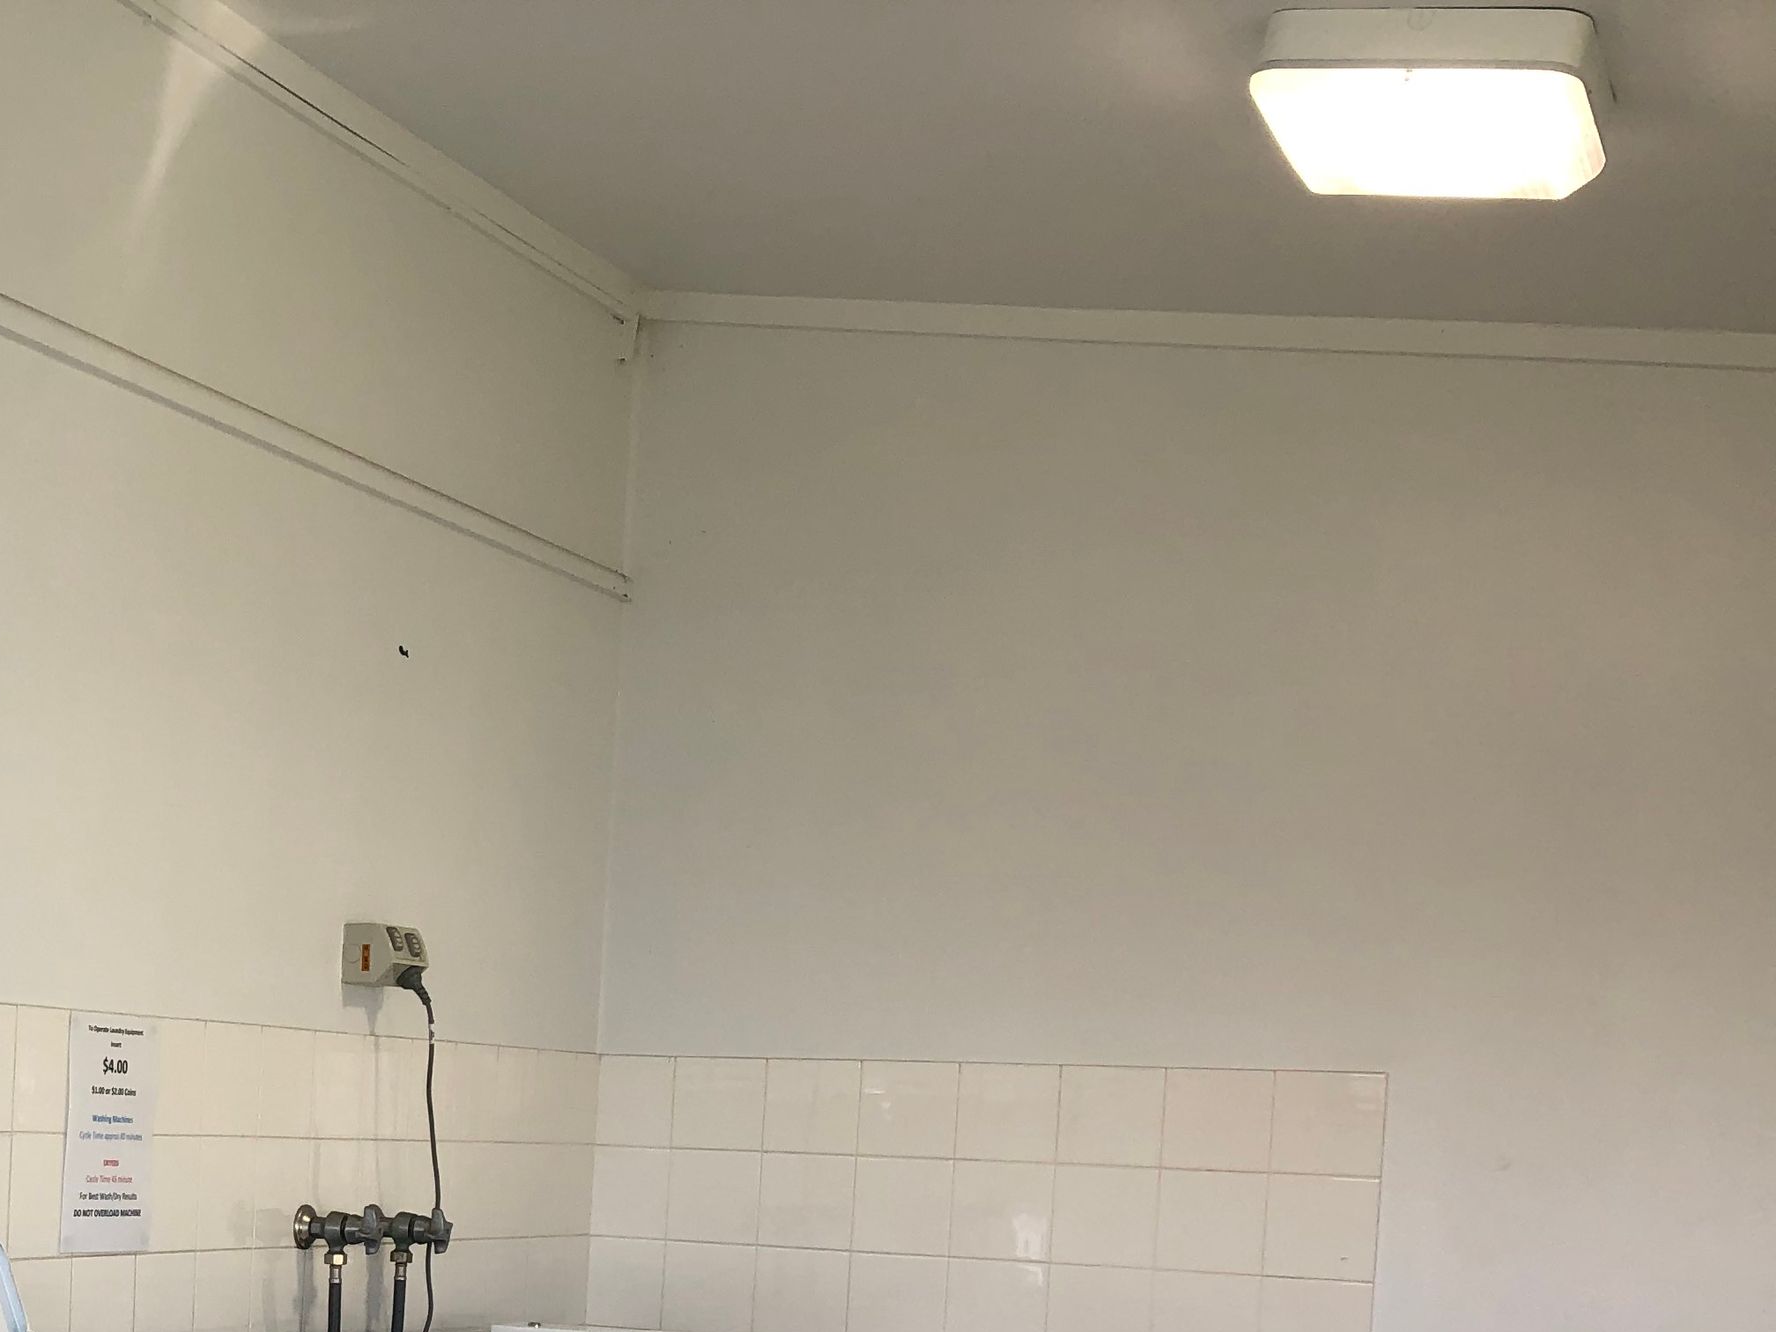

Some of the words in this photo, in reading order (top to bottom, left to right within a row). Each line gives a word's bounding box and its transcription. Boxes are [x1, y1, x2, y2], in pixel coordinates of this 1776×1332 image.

[103, 1056, 128, 1075] $4.00
[91, 1085, 105, 1095] $1.00
[111, 1086, 124, 1096] $2.00
[125, 1088, 136, 1096] Coins
[79, 1192, 87, 1200] For
[73, 1209, 82, 1217] DO
[82, 1209, 93, 1217] NOT
